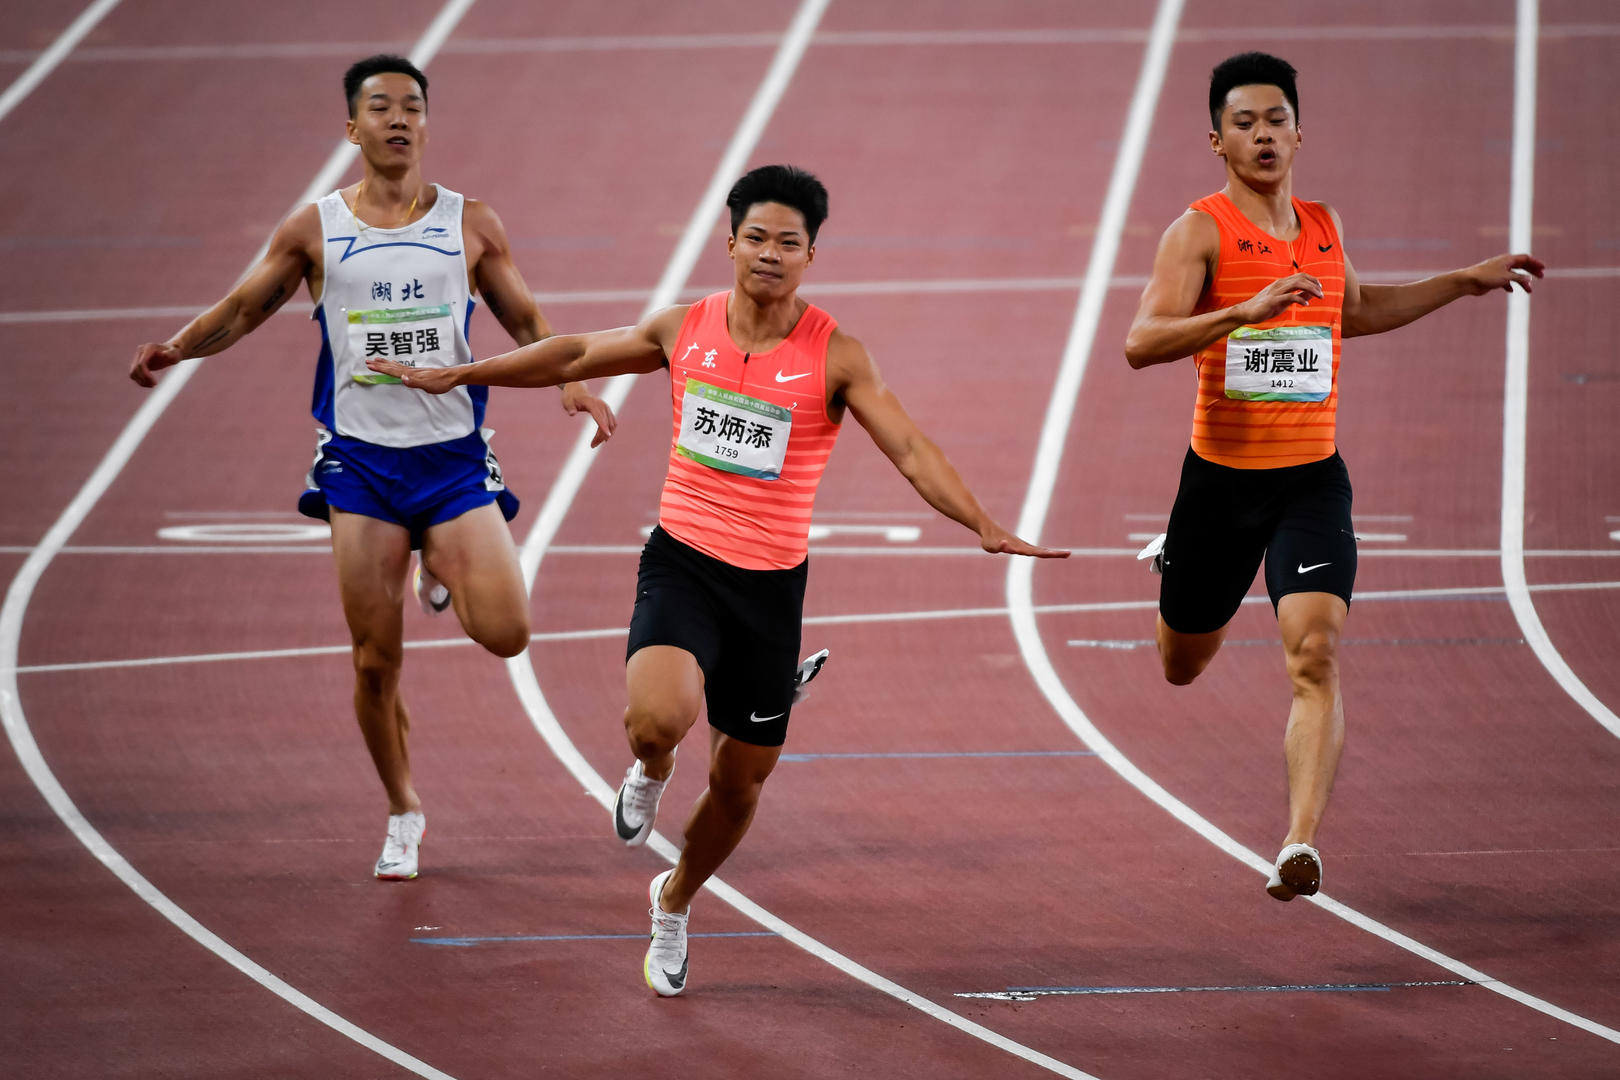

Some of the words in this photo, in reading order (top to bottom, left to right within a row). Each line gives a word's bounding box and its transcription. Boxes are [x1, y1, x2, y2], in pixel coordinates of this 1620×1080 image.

[1237, 238, 1273, 255] 浙江
[371, 278, 425, 303] 湖北
[365, 327, 441, 357] 吴智强
[680, 342, 718, 369] 广东
[1244, 347, 1319, 374] 谢震业
[1271, 379, 1294, 389] 1412
[694, 406, 773, 449] 苏炳添
[714, 445, 739, 459] 1759
